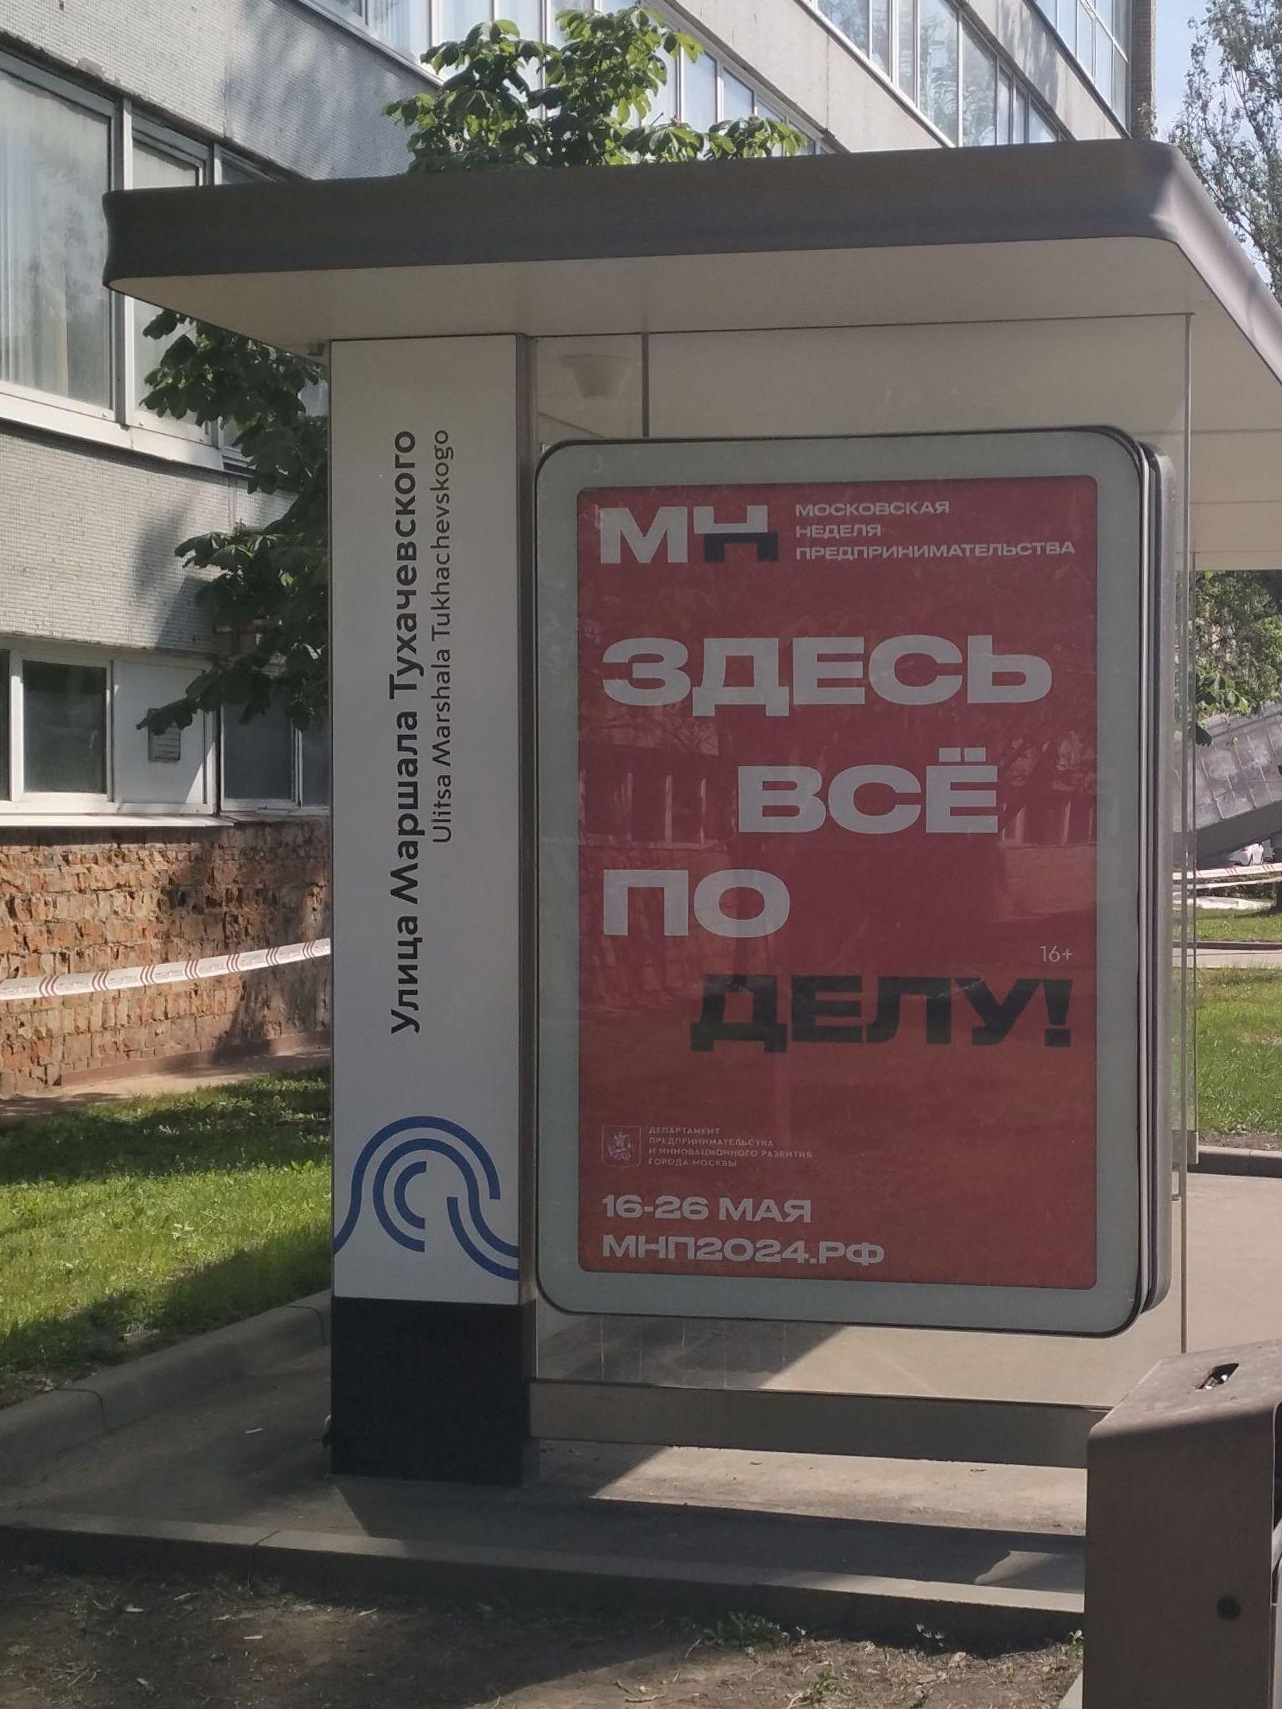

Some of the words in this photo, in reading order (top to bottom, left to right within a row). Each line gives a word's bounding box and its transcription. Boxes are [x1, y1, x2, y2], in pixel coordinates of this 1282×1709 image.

[795, 500, 950, 517] МОСКОВСКАЯ
[795, 522, 882, 540] НЕДЕЛЯ
[429, 429, 454, 642] Tukhachevskogo
[795, 541, 1076, 561] ПРЕДПРИНИМАТЕЛЬСТВА
[388, 430, 425, 700] Тухачевского
[602, 634, 1053, 717] ЗДЕСЬ
[430, 649, 451, 768] Marshala
[389, 711, 426, 905] Маршала
[430, 774, 452, 843] Ulitsa
[737, 746, 999, 835] ВСЁ
[602, 868, 791, 938] ПО
[390, 915, 423, 1035] Улица
[1039, 945, 1073, 963] 16+
[689, 973, 1073, 1054] ДЕЛУ!
[648, 1126, 722, 1136] ДЕПАРТАМЕНТ
[648, 1136, 774, 1148] ПРЕДПРИНИМАТЕЛЬСТВА
[648, 1148, 657, 1156] И
[659, 1148, 758, 1158] ИННОВАЦИОННОГО
[761, 1150, 813, 1159] РАЗВИТИЯ
[648, 1158, 689, 1167] ГОРОДА
[692, 1159, 738, 1168] МОСКВЫ
[602, 1194, 709, 1221] 16-26
[718, 1197, 812, 1224] МАЯ
[602, 1234, 885, 1266] МНП2024.РФ
